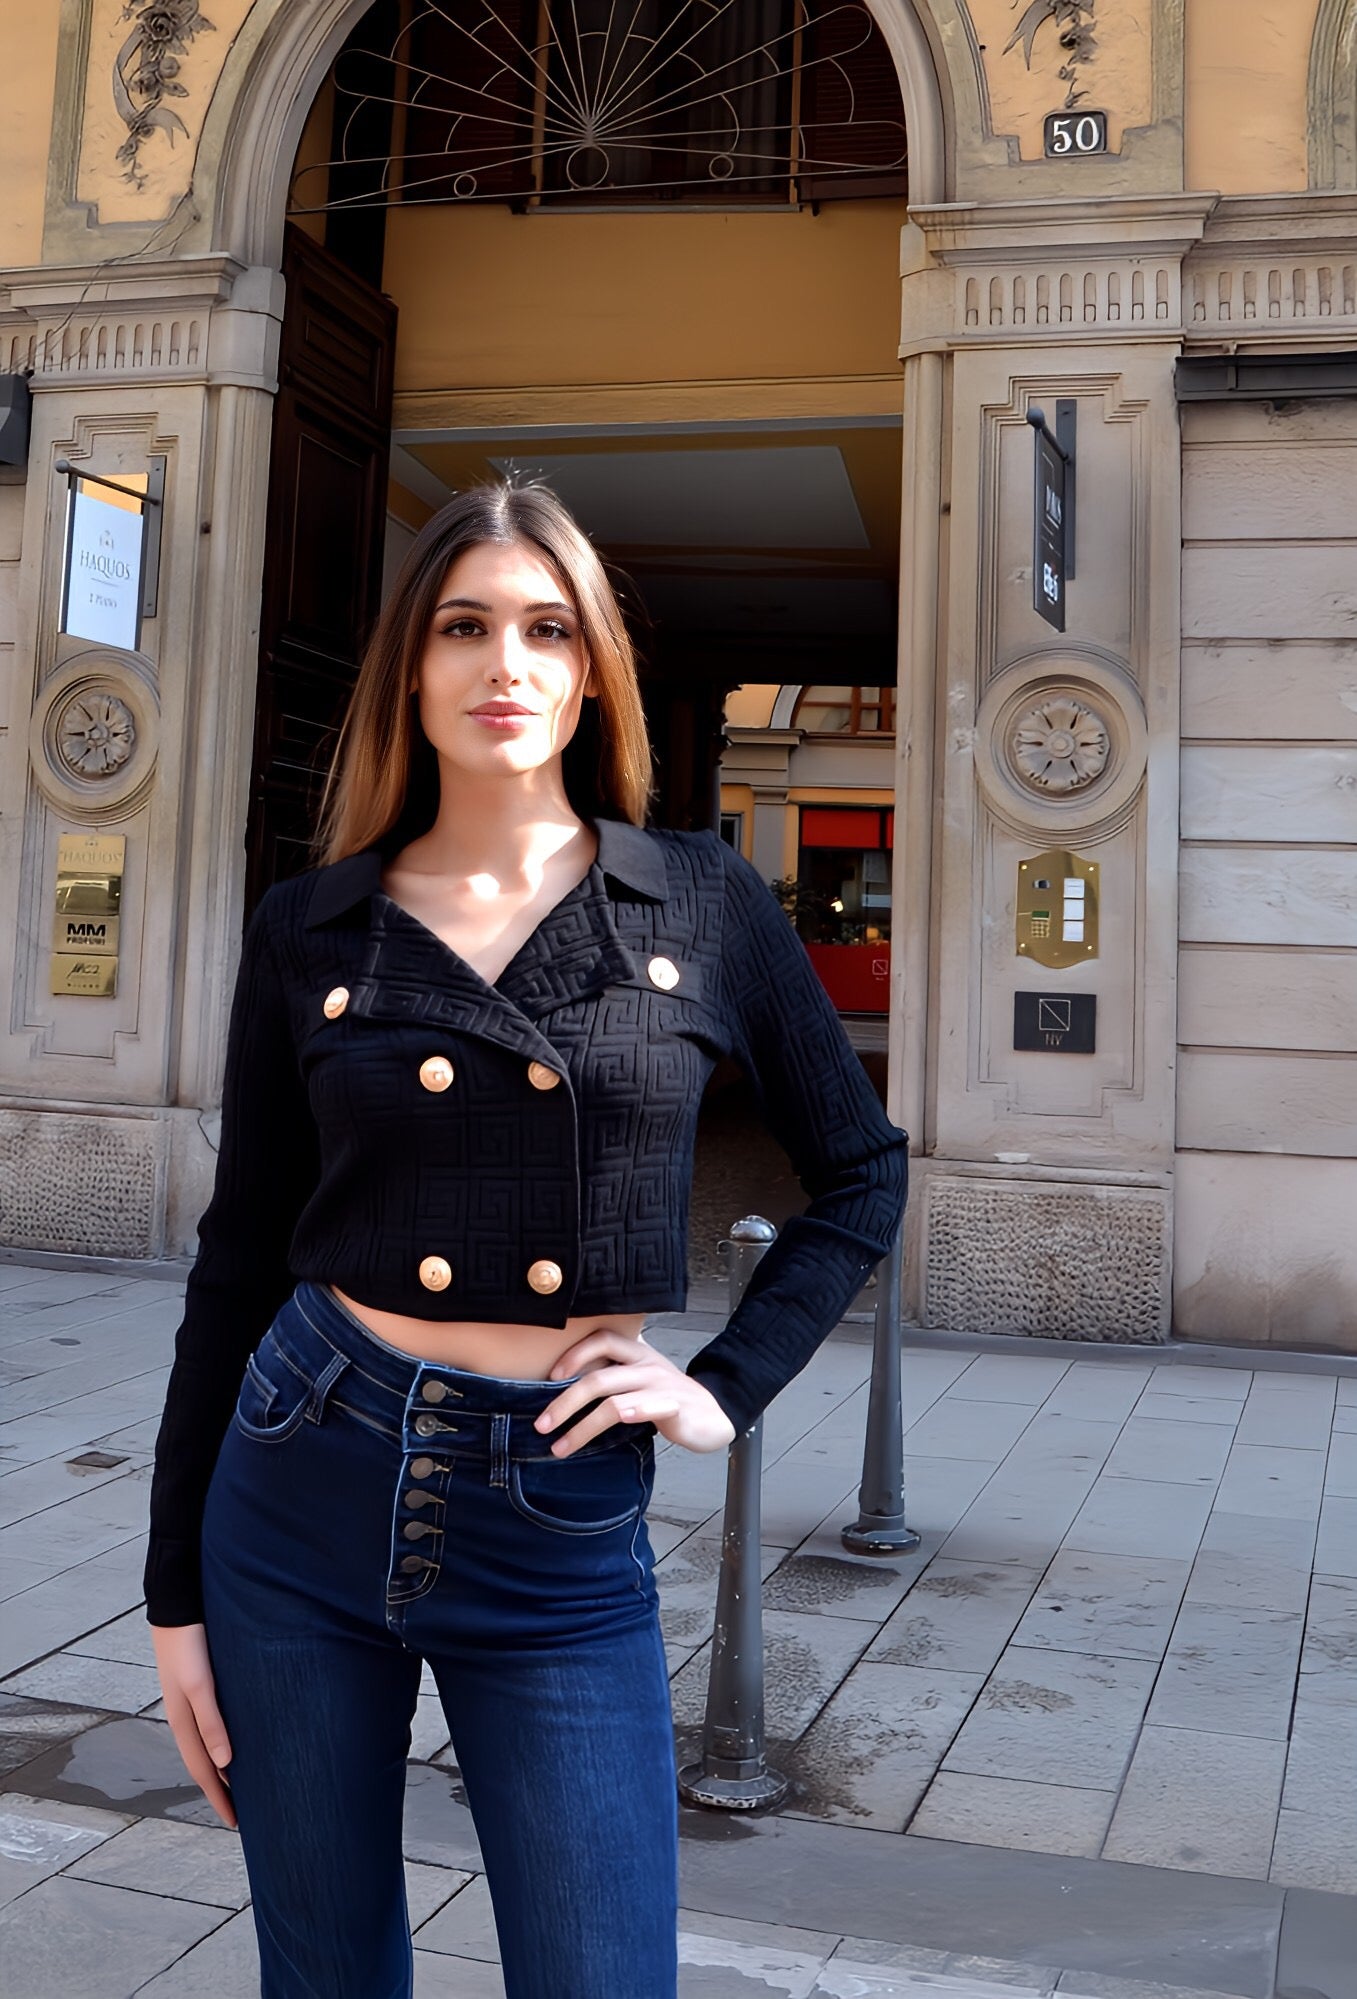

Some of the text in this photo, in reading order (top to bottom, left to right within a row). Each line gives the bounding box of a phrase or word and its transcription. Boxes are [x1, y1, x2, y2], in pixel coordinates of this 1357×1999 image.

[1053, 116, 1100, 153] 50
[80, 549, 131, 580] HAQUOS
[67, 923, 106, 937] MM
